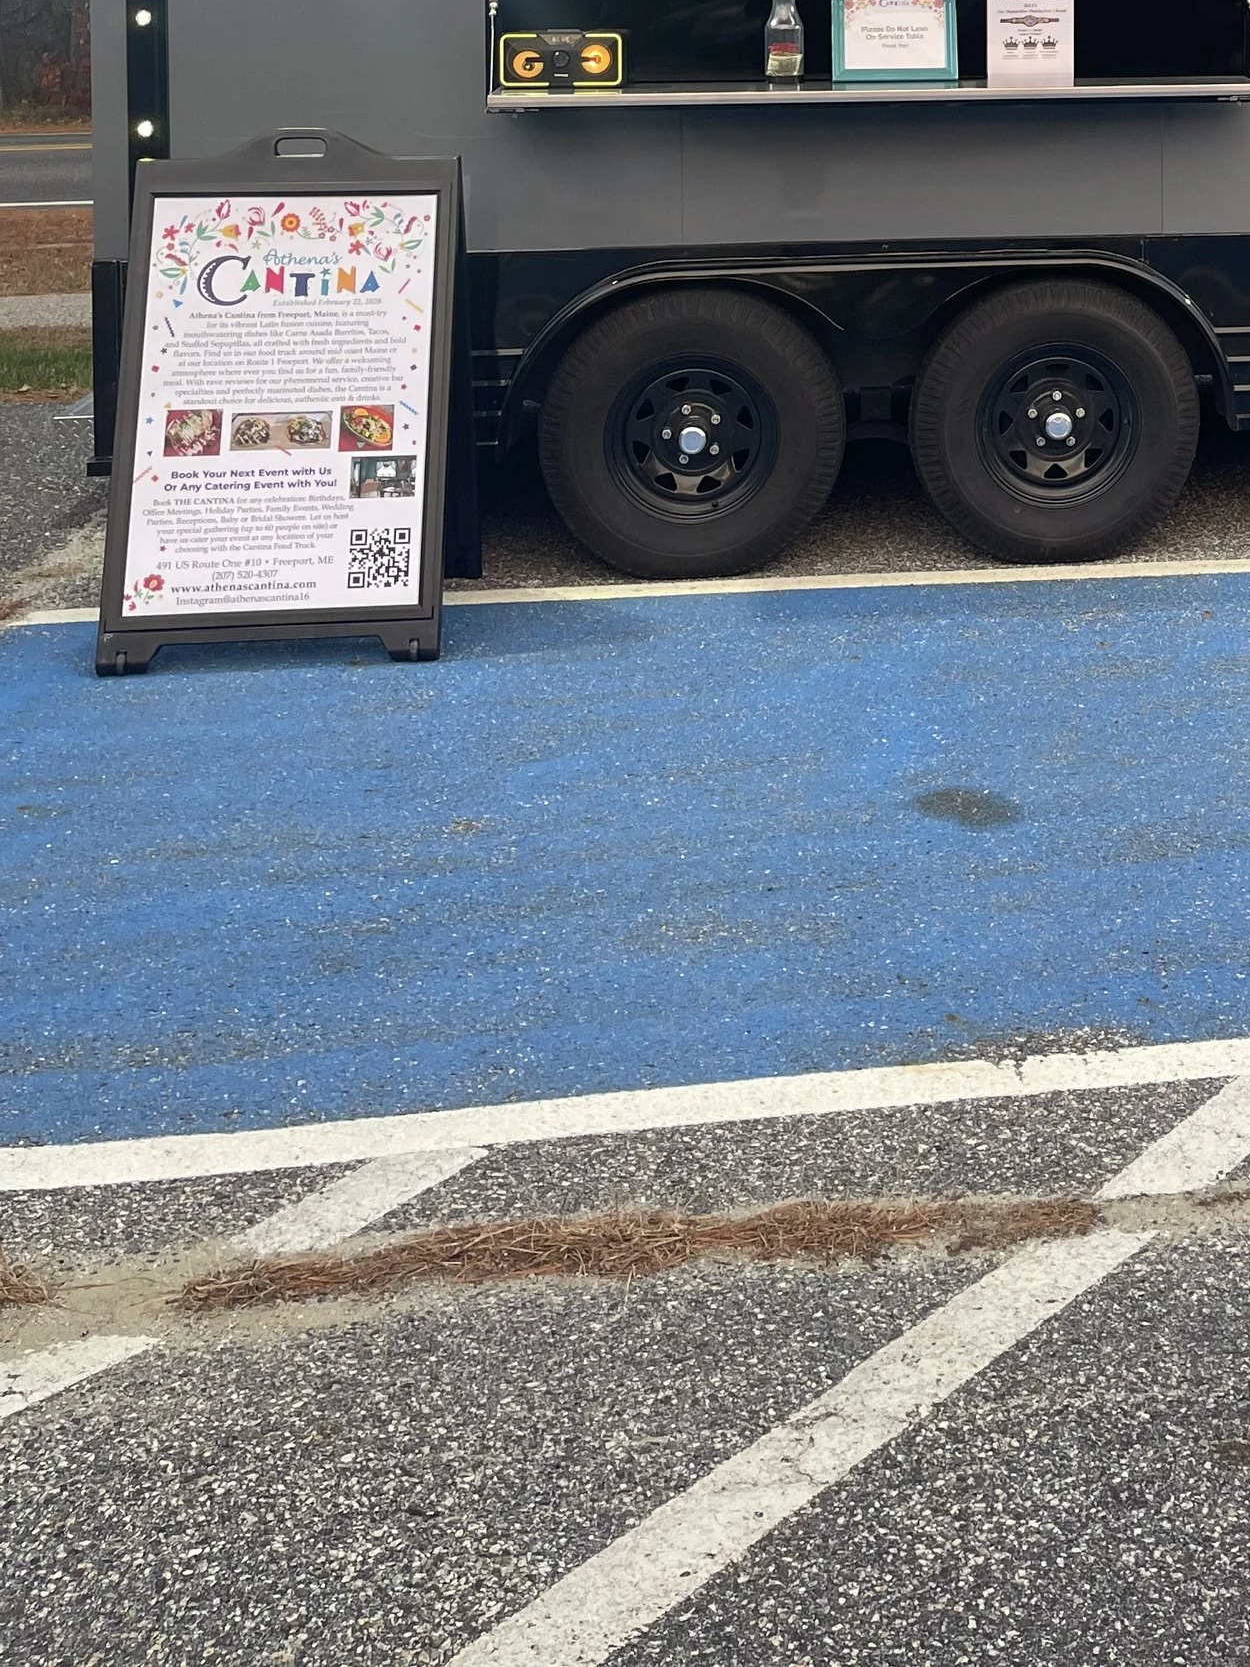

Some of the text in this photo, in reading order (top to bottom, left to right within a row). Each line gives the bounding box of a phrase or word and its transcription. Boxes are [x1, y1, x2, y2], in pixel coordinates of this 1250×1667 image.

[262, 248, 342, 266] Athena's
[355, 310, 386, 318] must-try
[171, 470, 198, 478] Book
[230, 469, 255, 477] Next
[258, 468, 288, 476] Event
[318, 467, 331, 475] Us
[180, 483, 201, 492] Any
[204, 481, 250, 492] Catering
[315, 479, 337, 487] You!
[156, 561, 171, 569] 491
[175, 560, 189, 568] US
[192, 559, 219, 568] Route
[221, 559, 241, 567] One
[244, 558, 261, 566] #10
[317, 556, 333, 564] ME
[212, 569, 277, 580] (207) 520-4307
[171, 580, 316, 592] www.athenascantina.com
